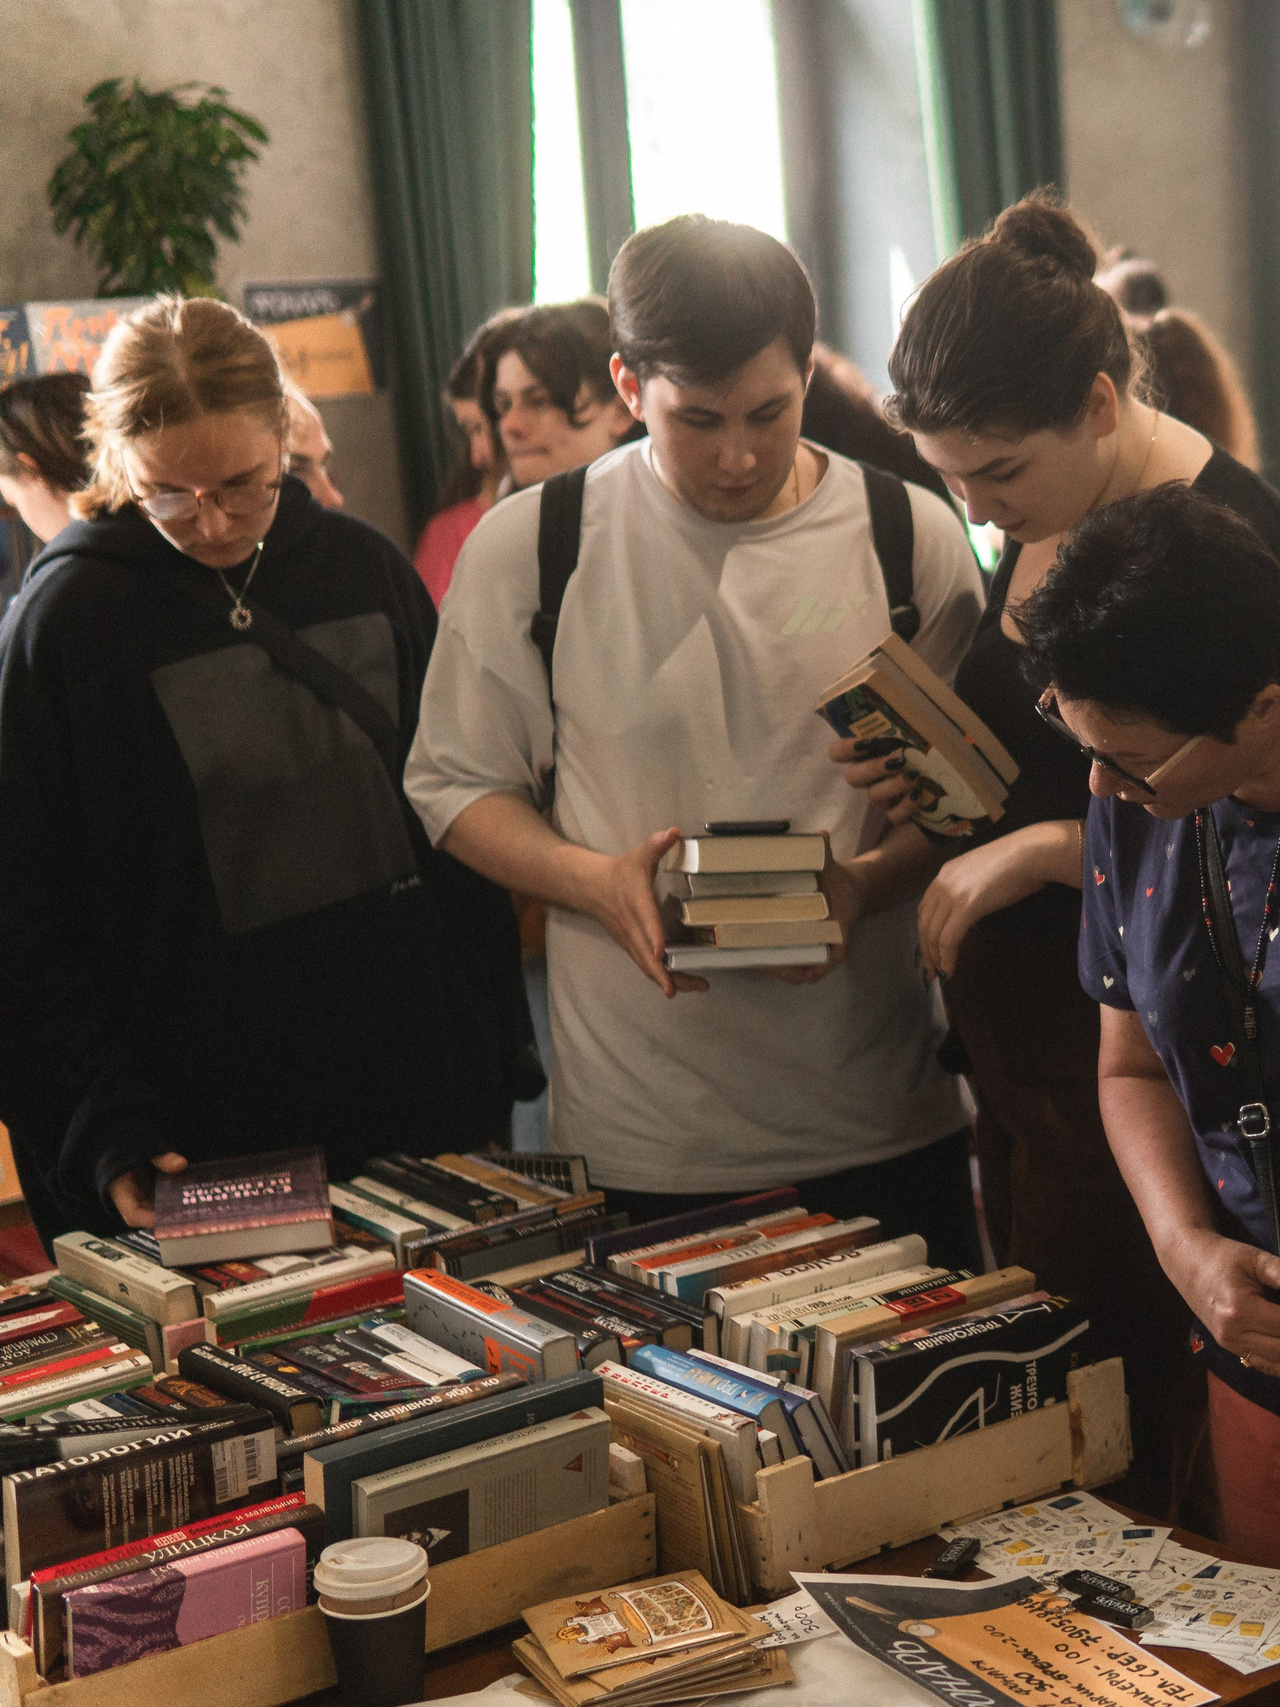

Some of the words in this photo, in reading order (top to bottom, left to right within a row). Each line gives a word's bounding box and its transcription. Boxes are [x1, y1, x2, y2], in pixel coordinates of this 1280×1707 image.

[898, 1272, 958, 1297] ШАМАНИЗМ
[914, 1315, 1003, 1351] ТРЕУГОЛЬНАЯ
[611, 1372, 669, 1399] ВЕЛЛЕР
[1026, 1360, 1038, 1410] ТРЕУГО
[324, 1418, 363, 1435] КАНТОР
[8, 1427, 193, 1484] ПАТОЛОГИИ
[244, 1497, 300, 1520] маленькие
[141, 1523, 252, 1563] УЛИЦКАЯ
[1055, 1643, 1091, 1666] 100
[887, 1641, 995, 1707] ОНАРЬ
